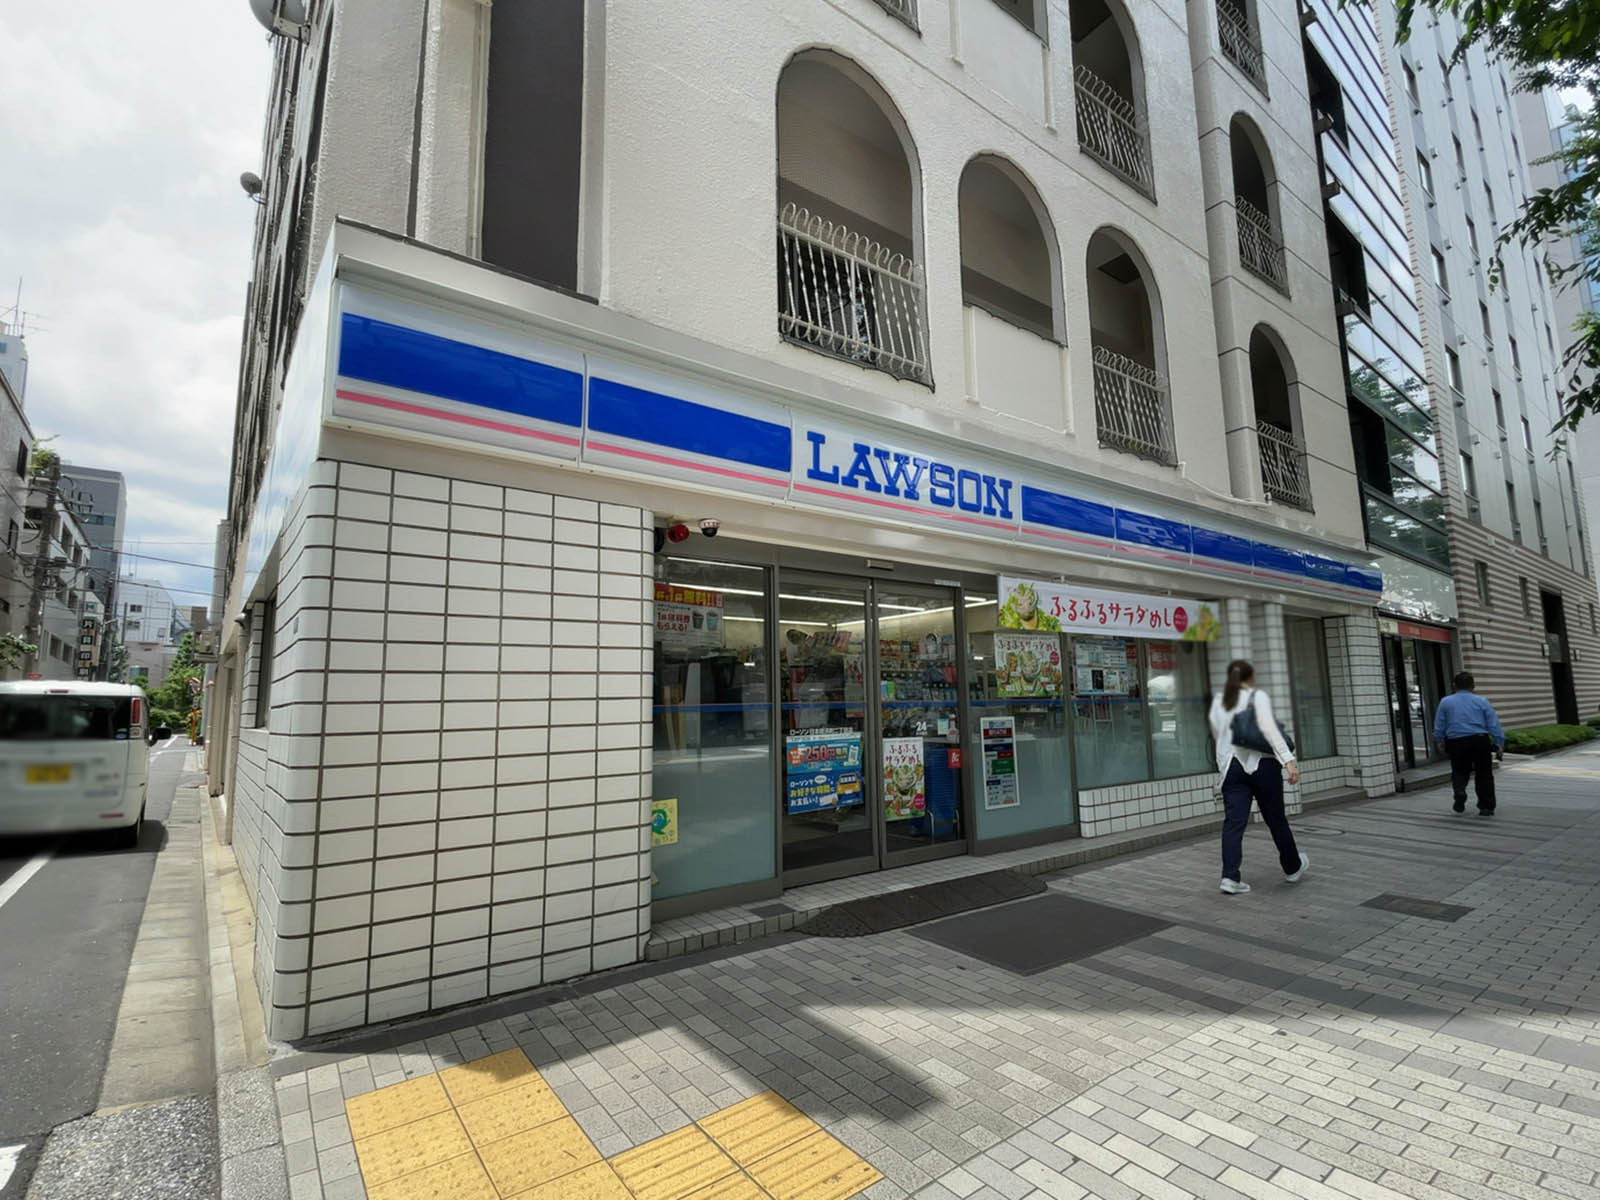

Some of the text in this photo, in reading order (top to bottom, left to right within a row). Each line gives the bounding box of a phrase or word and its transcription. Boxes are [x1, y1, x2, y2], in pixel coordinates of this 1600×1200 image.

[806, 430, 1013, 519] LAWSON
[1050, 597, 1171, 629] ふるふるサラダめし
[998, 639, 1057, 651] ふるふるサラダめし
[915, 721, 928, 731] 24
[889, 744, 917, 755] ふるふる
[885, 753, 920, 765] サラダめし
